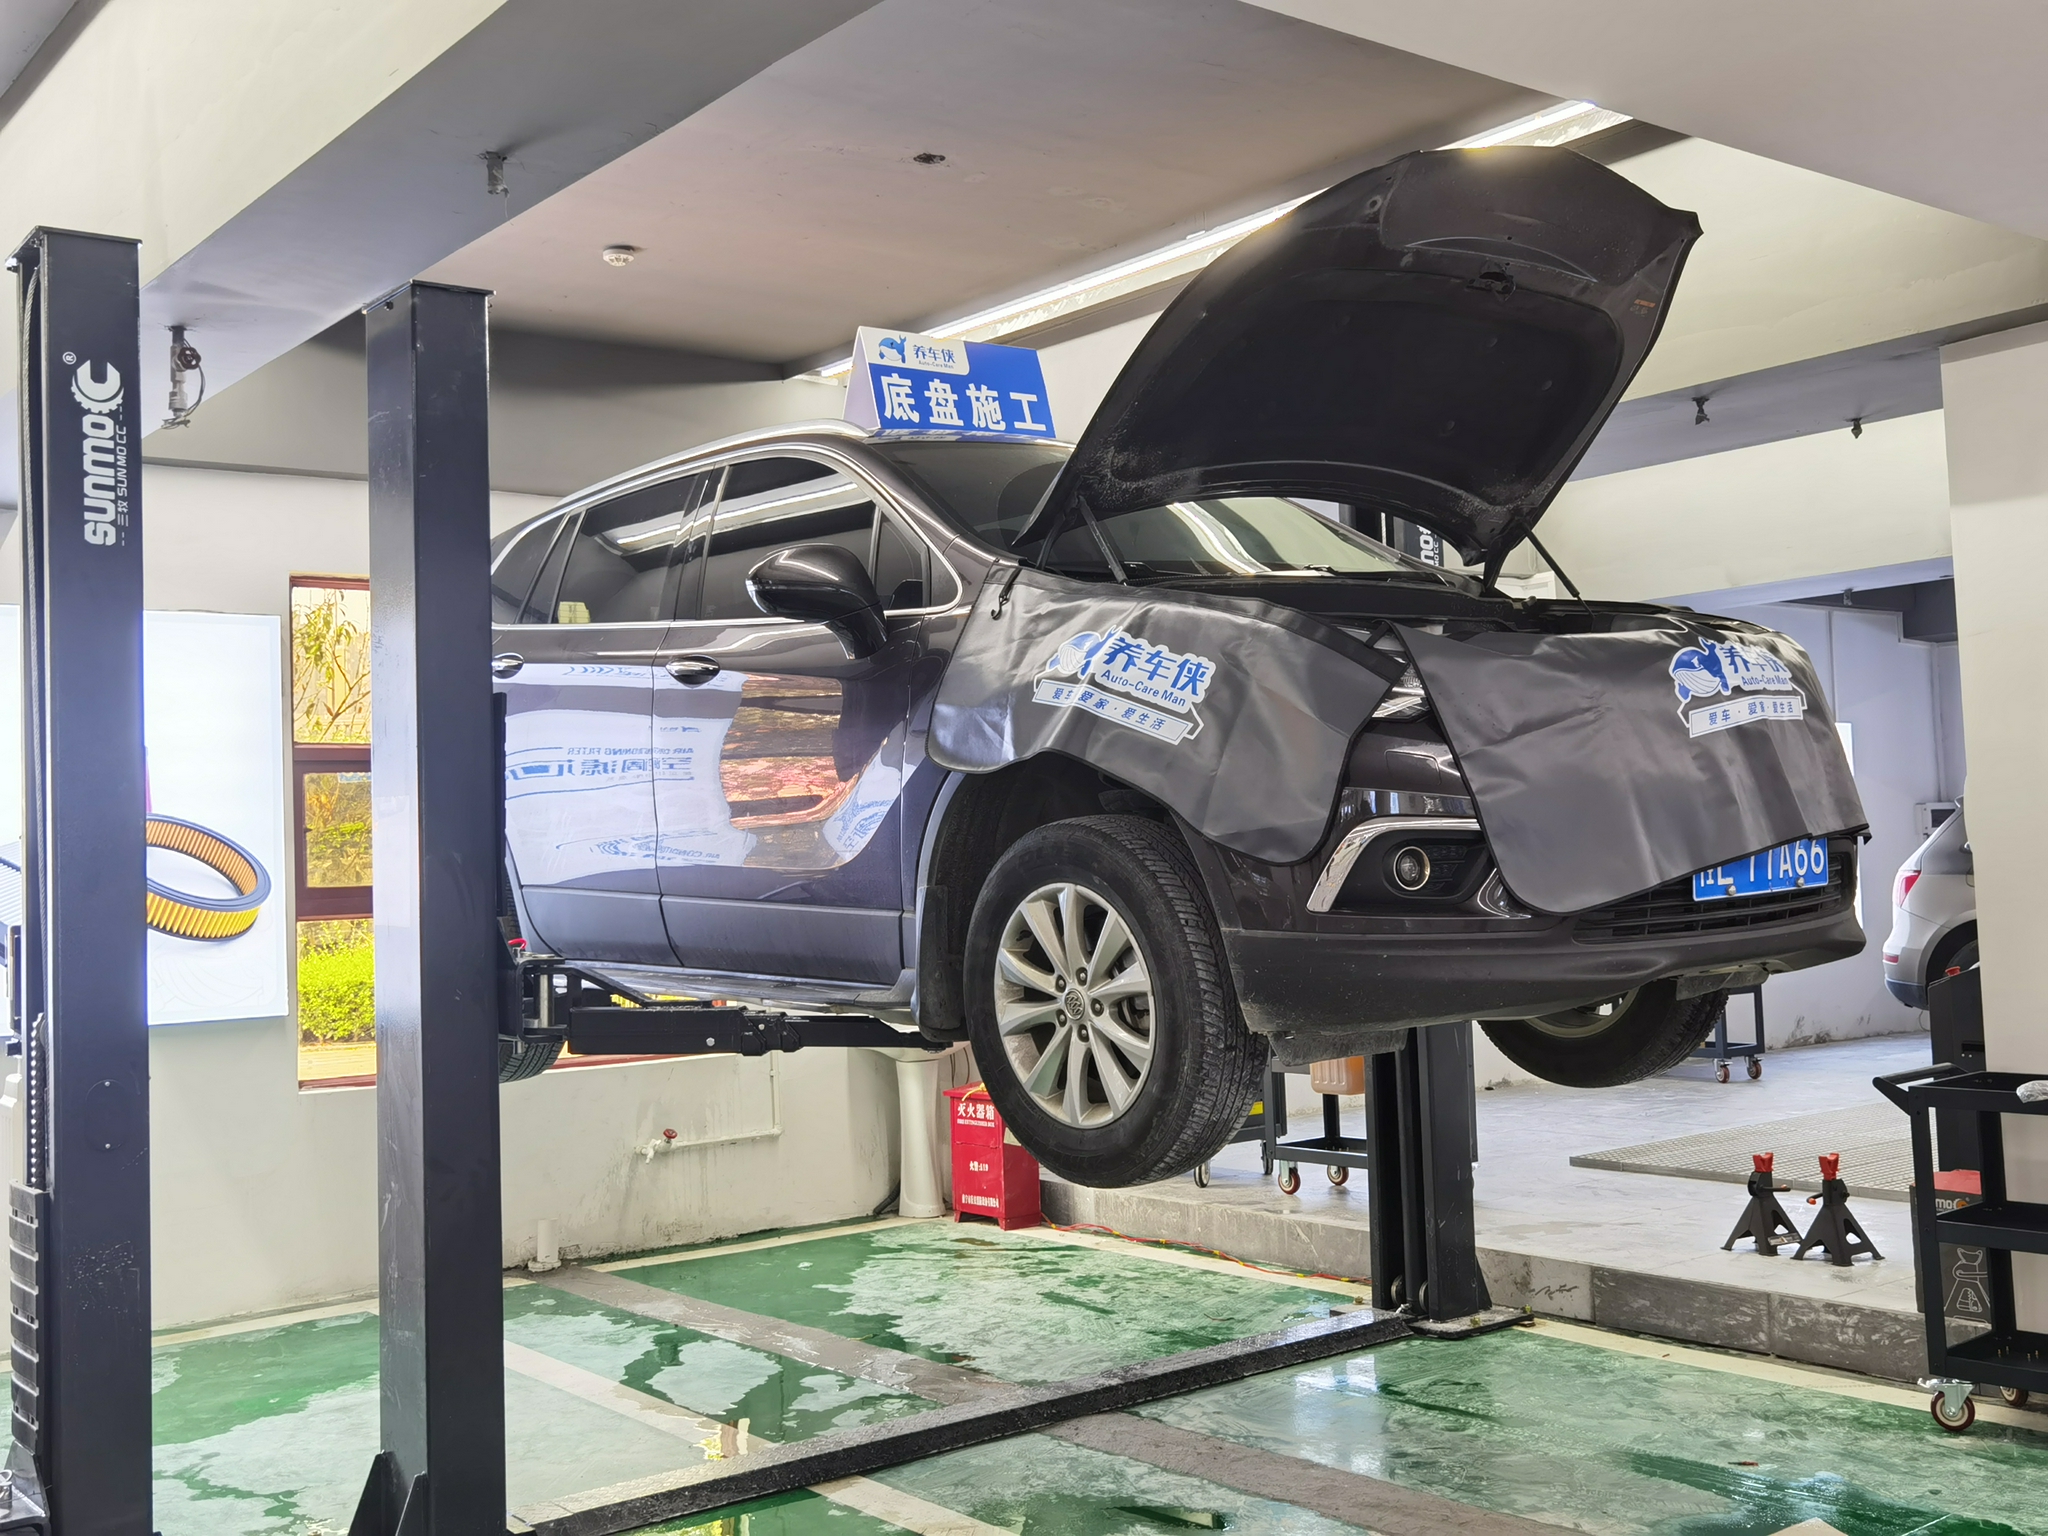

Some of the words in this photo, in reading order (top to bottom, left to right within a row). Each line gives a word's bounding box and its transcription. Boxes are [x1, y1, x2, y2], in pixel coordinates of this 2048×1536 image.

[913, 344, 956, 364] 养车侠
[880, 373, 1047, 431] 底盘施工
[1103, 637, 1209, 696] 养车侠
[1741, 674, 1775, 686] Auto-Care
[1774, 674, 1789, 685] Man
[1101, 669, 1159, 697] Auto-Care
[1161, 690, 1186, 707] Man
[957, 1103, 994, 1120] 灭火器箱
